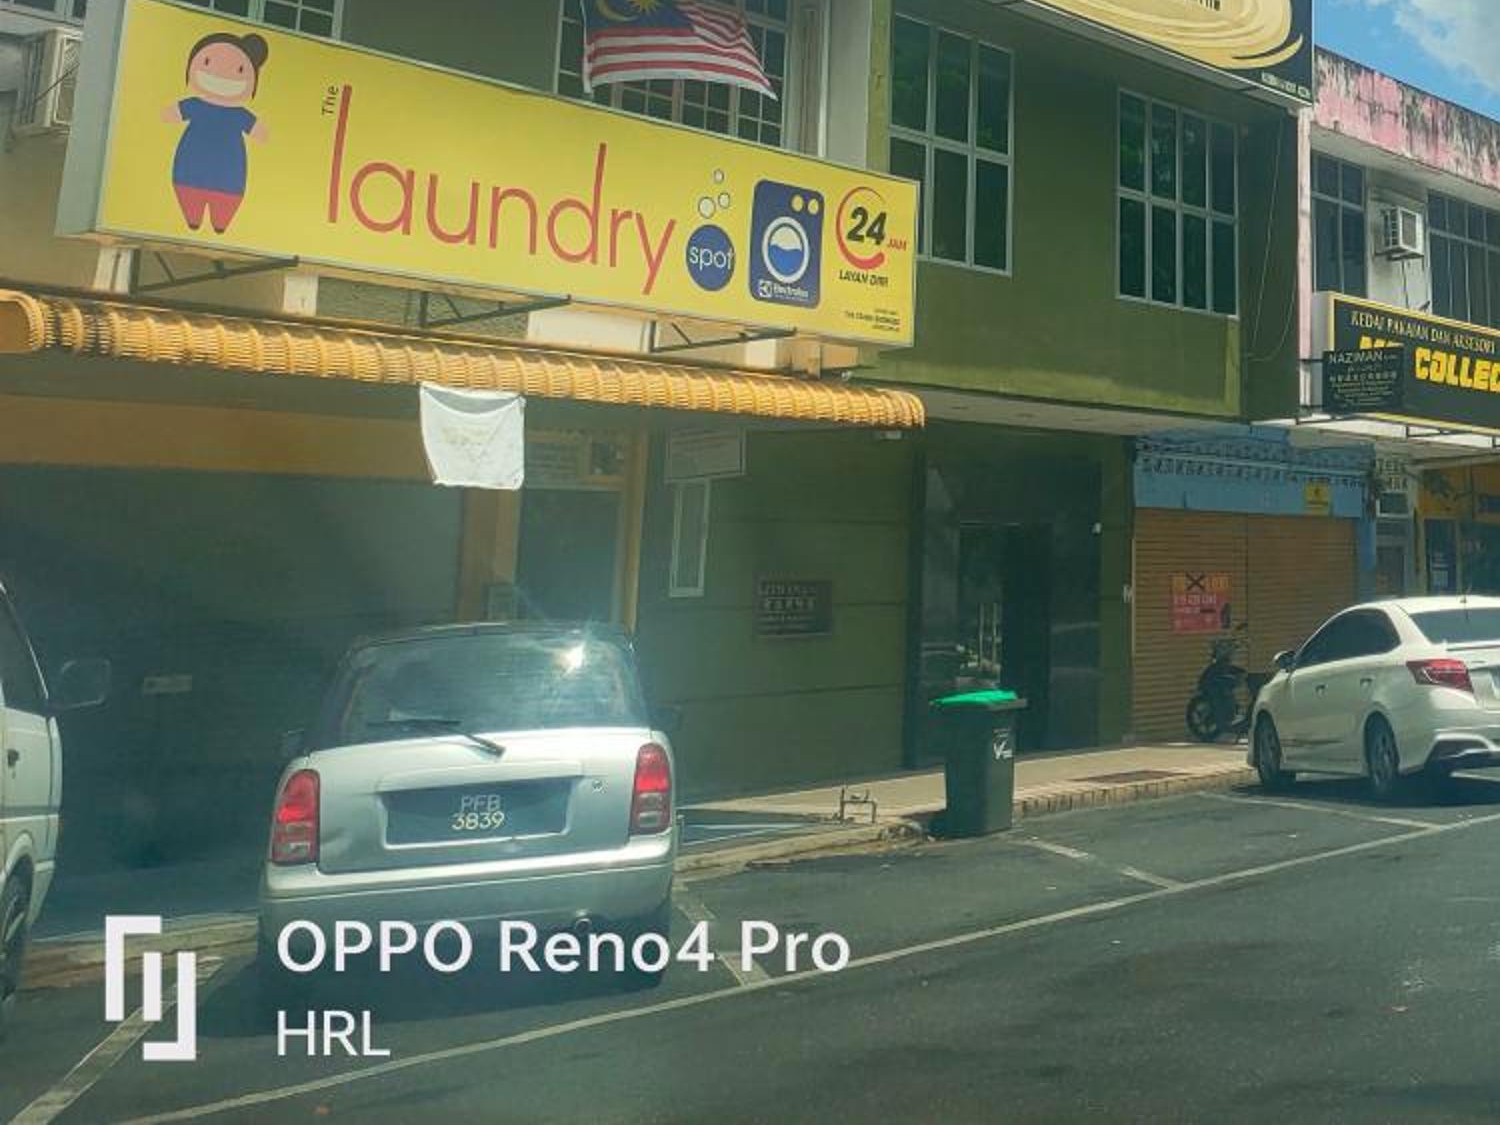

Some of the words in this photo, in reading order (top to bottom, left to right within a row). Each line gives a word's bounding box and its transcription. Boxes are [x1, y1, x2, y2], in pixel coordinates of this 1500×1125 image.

[321, 84, 339, 116] The
[327, 84, 676, 296] laundry
[847, 206, 888, 246] 24
[689, 246, 735, 271] spot
[451, 810, 505, 830] 3839
